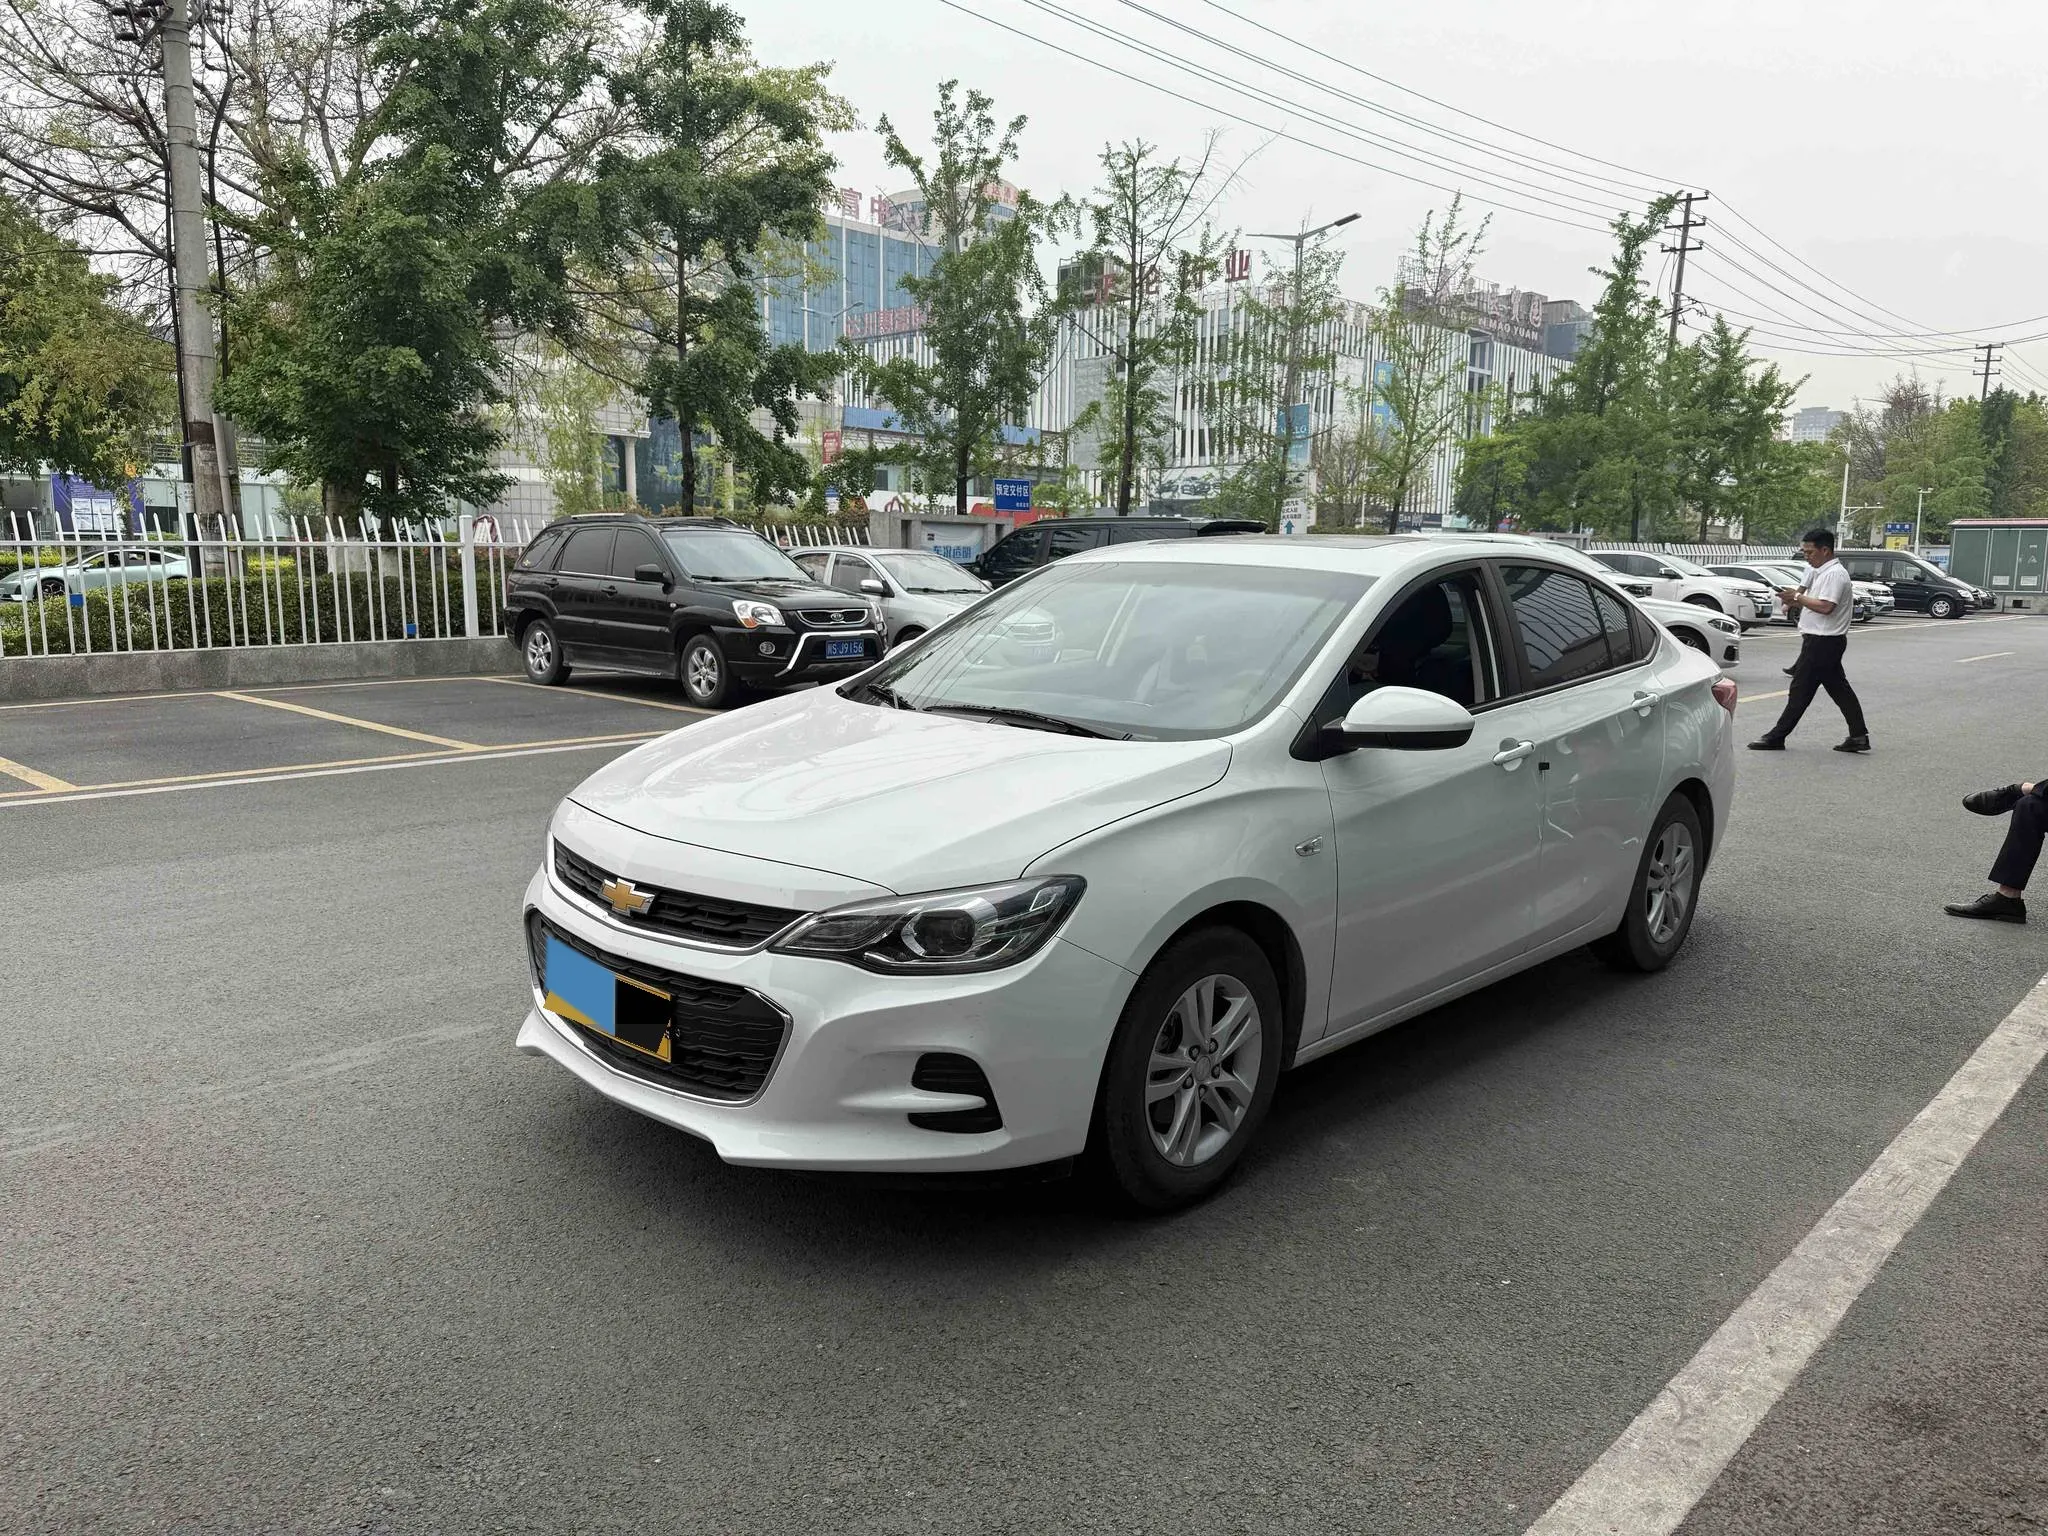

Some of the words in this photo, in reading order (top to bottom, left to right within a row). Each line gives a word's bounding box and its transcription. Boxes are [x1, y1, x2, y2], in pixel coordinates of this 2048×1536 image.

[1513, 326, 1538, 341] YUAN
[995, 483, 1029, 497] 预定交付区
